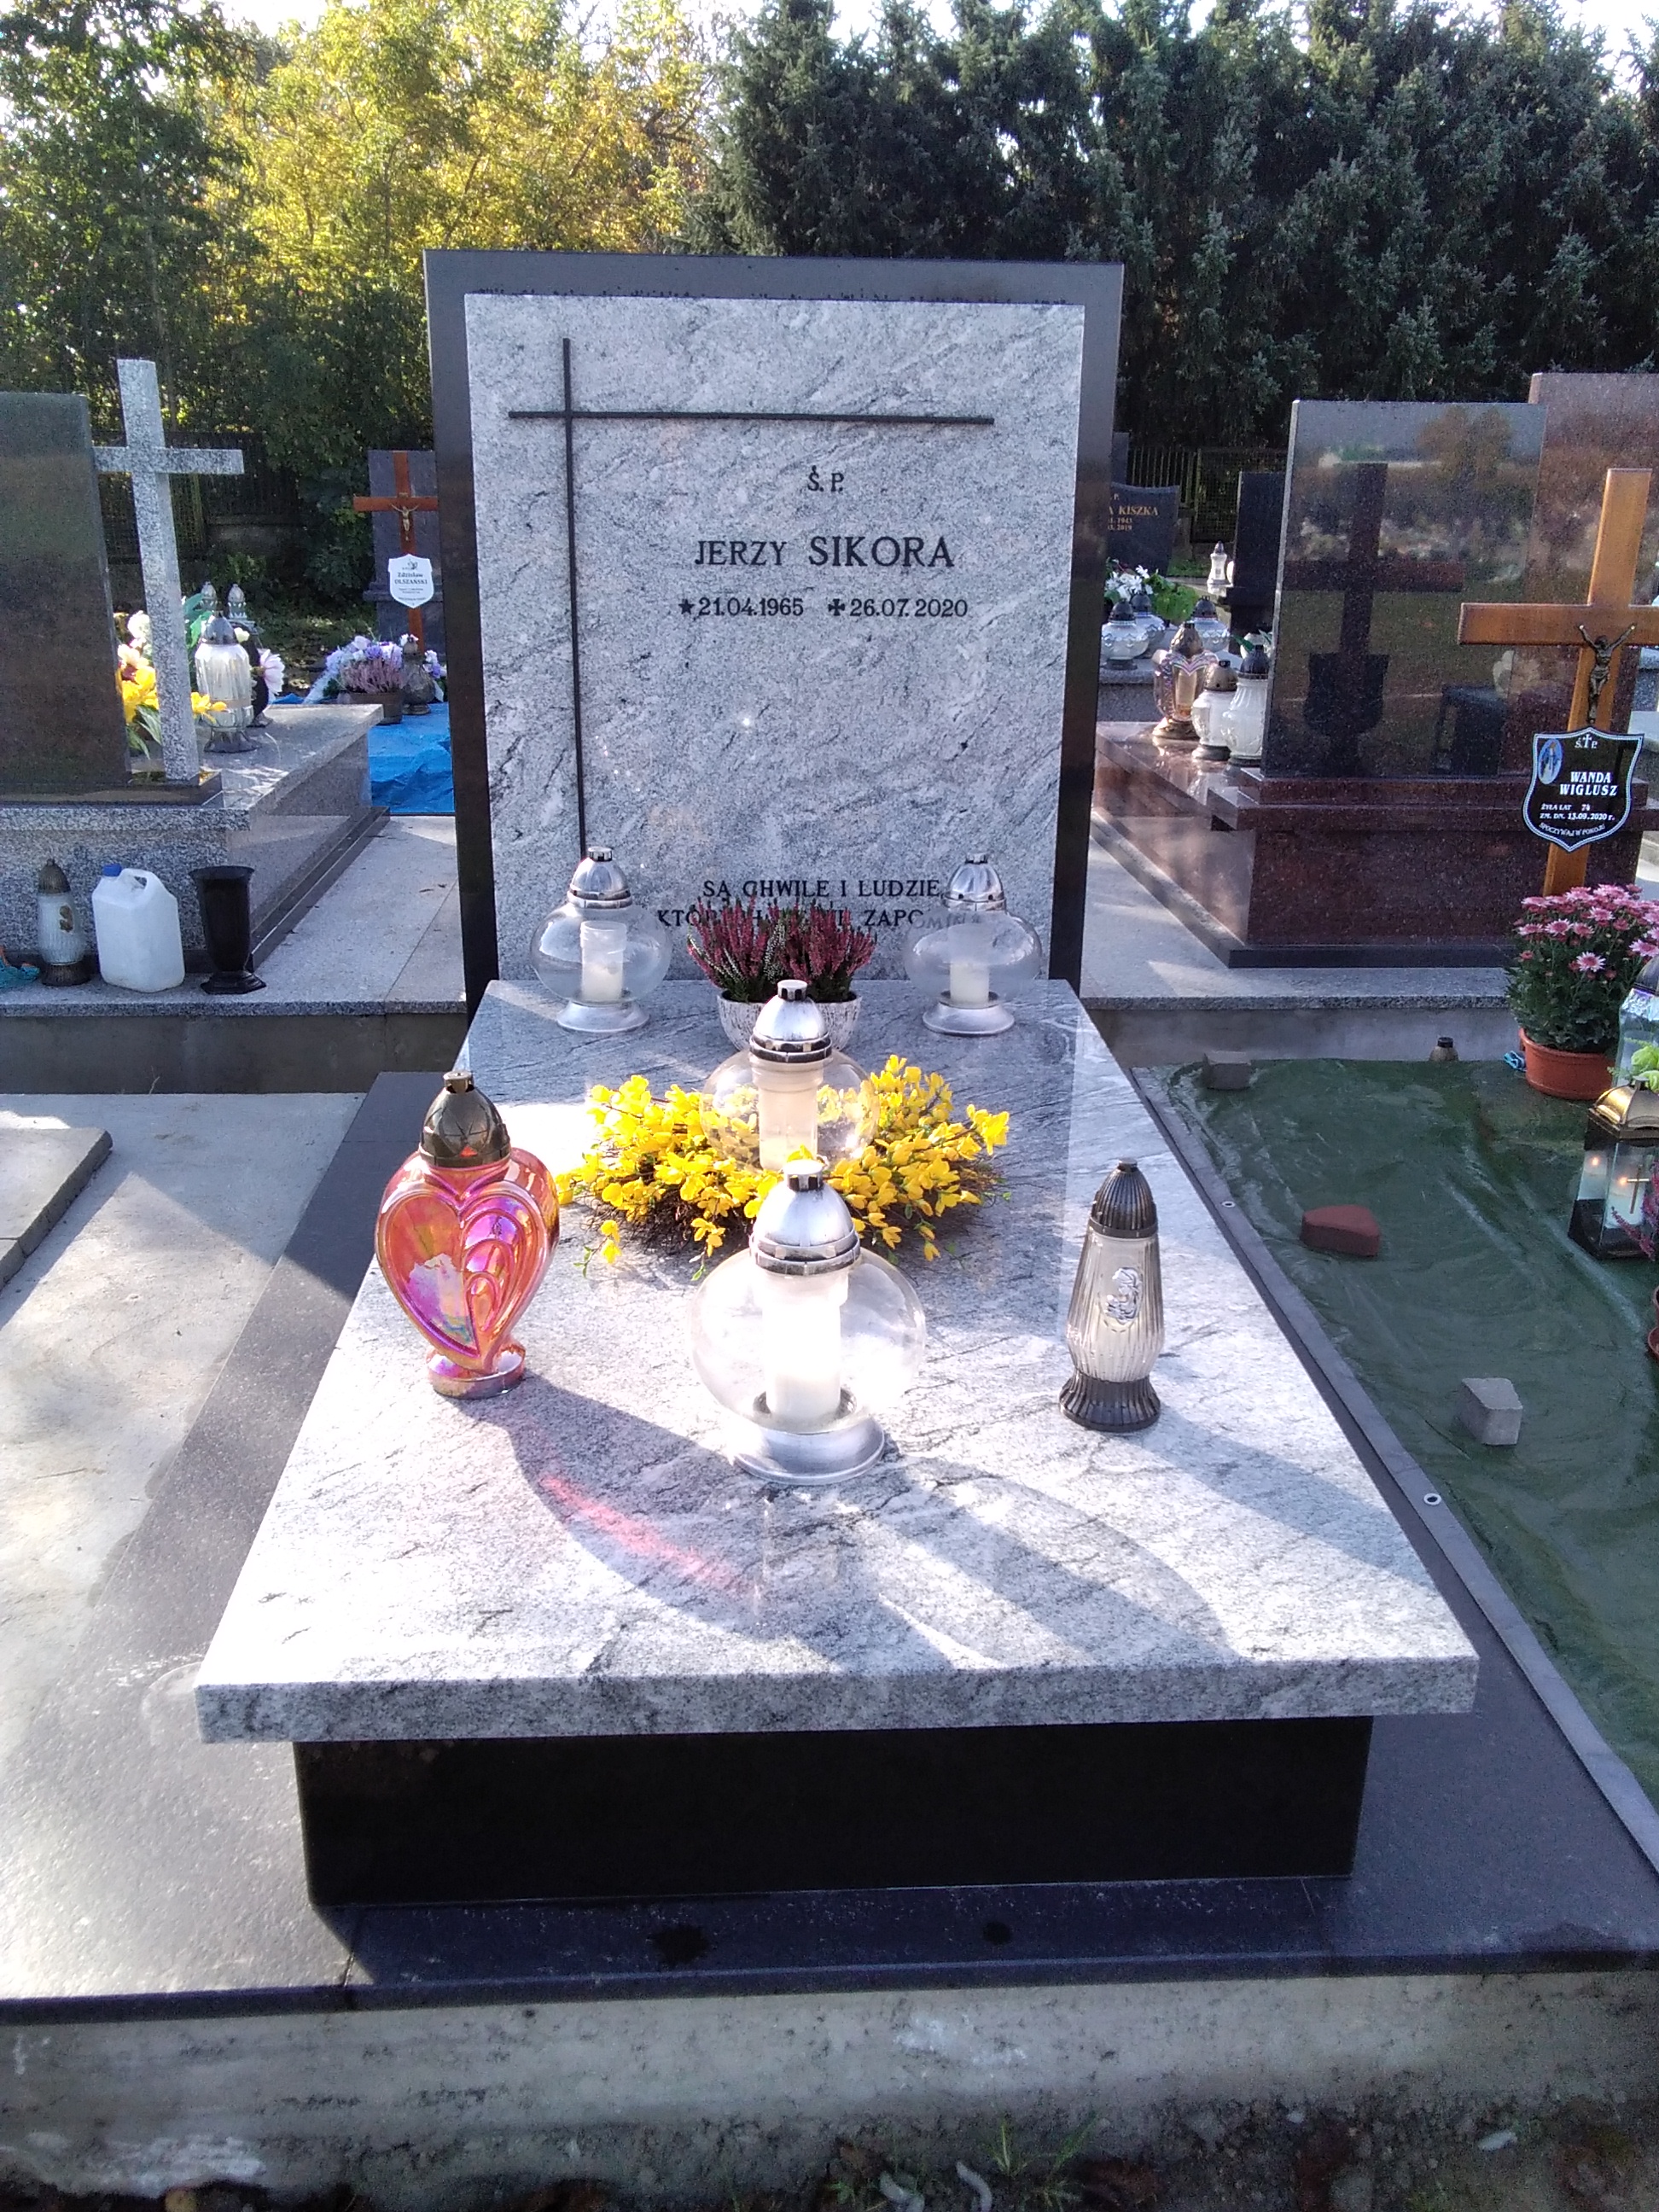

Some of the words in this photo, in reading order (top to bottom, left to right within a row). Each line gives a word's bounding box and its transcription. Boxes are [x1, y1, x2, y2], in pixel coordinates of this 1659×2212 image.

[1119, 505, 1158, 516] KISZKA
[694, 540, 788, 566] JERZY
[808, 536, 955, 568] SIKORA
[698, 597, 804, 617] 21.04.1965
[849, 597, 969, 618] 26.07.2020
[1570, 771, 1611, 783] WANDA
[1559, 784, 1618, 796] WIGLUSZ
[1539, 822, 1574, 836] SPOCZYWAJ
[703, 880, 731, 902] SĄ
[742, 880, 830, 897] CHWILE
[840, 880, 847, 897] I
